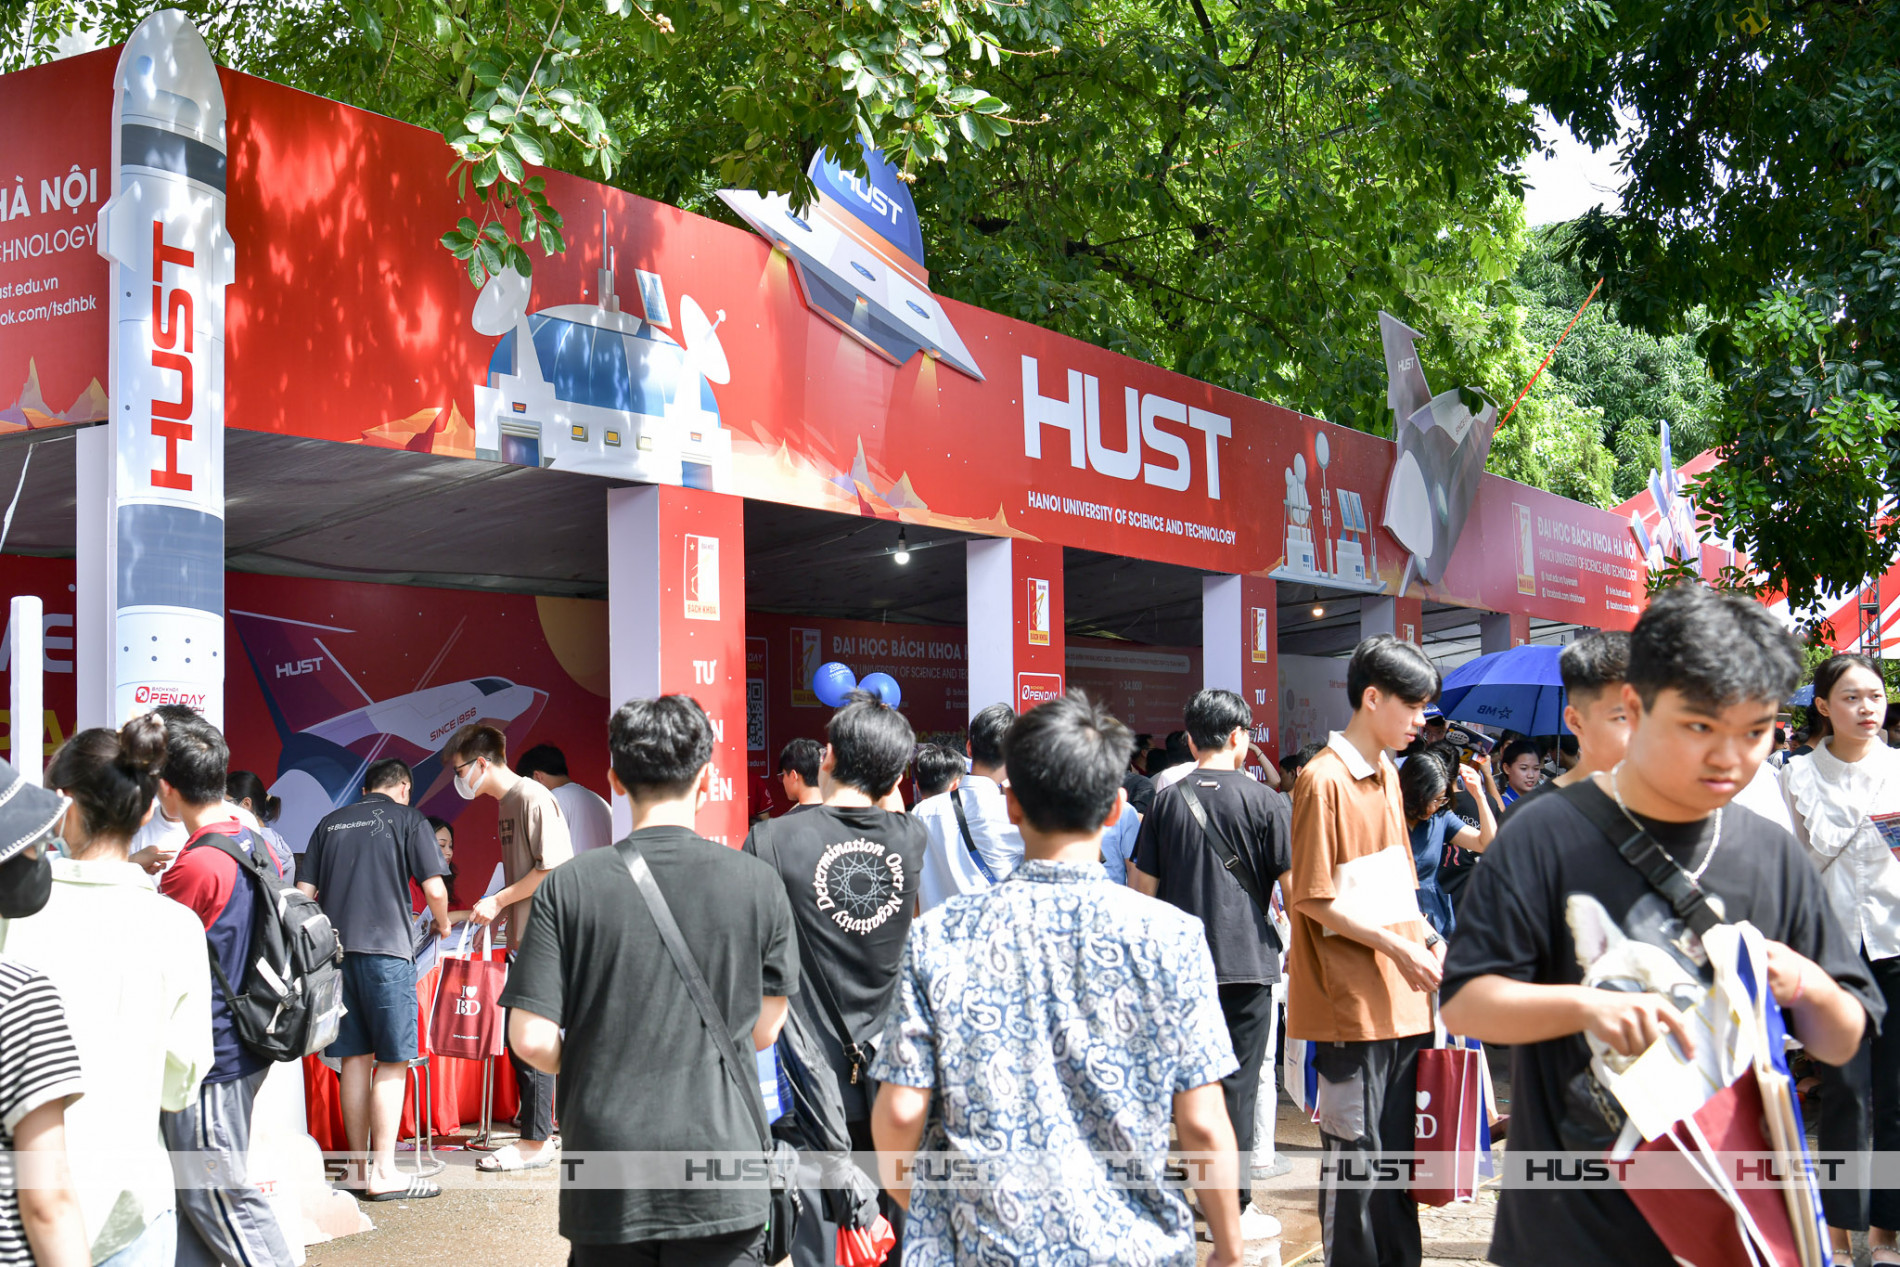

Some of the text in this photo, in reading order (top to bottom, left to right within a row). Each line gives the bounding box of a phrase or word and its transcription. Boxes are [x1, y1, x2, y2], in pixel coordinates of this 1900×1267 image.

[41, 164, 97, 215] NỘI
[838, 170, 903, 225] HUST
[0, 223, 97, 263] HNOLOGY
[151, 220, 194, 491] HUST
[1398, 357, 1414, 372] HUST
[1021, 354, 1232, 500] HUST
[1028, 491, 1236, 545] HANOI UNIVERSITY OF SCIENCE AND TECHNOLOGY
[1538, 516, 1552, 541] ĐẠI
[1553, 520, 1570, 546] HỌC
[1571, 522, 1592, 549] BÁCH
[1592, 531, 1612, 555] KHOA
[1613, 533, 1623, 558] HÀ
[833, 635, 962, 660] ĐẠI HỌC BÁCH KHOA
[275, 657, 324, 678] HUST
[693, 659, 717, 685] TƯ
[900, 666, 910, 677] OF
[911, 666, 941, 679] SCIENCE
[180, 693, 206, 705] DAY
[1255, 688, 1266, 705] TƯ
[430, 719, 456, 742] SINCE
[334, 819, 376, 831] BlackBerry
[812, 837, 904, 935] Determination Over Negativity
